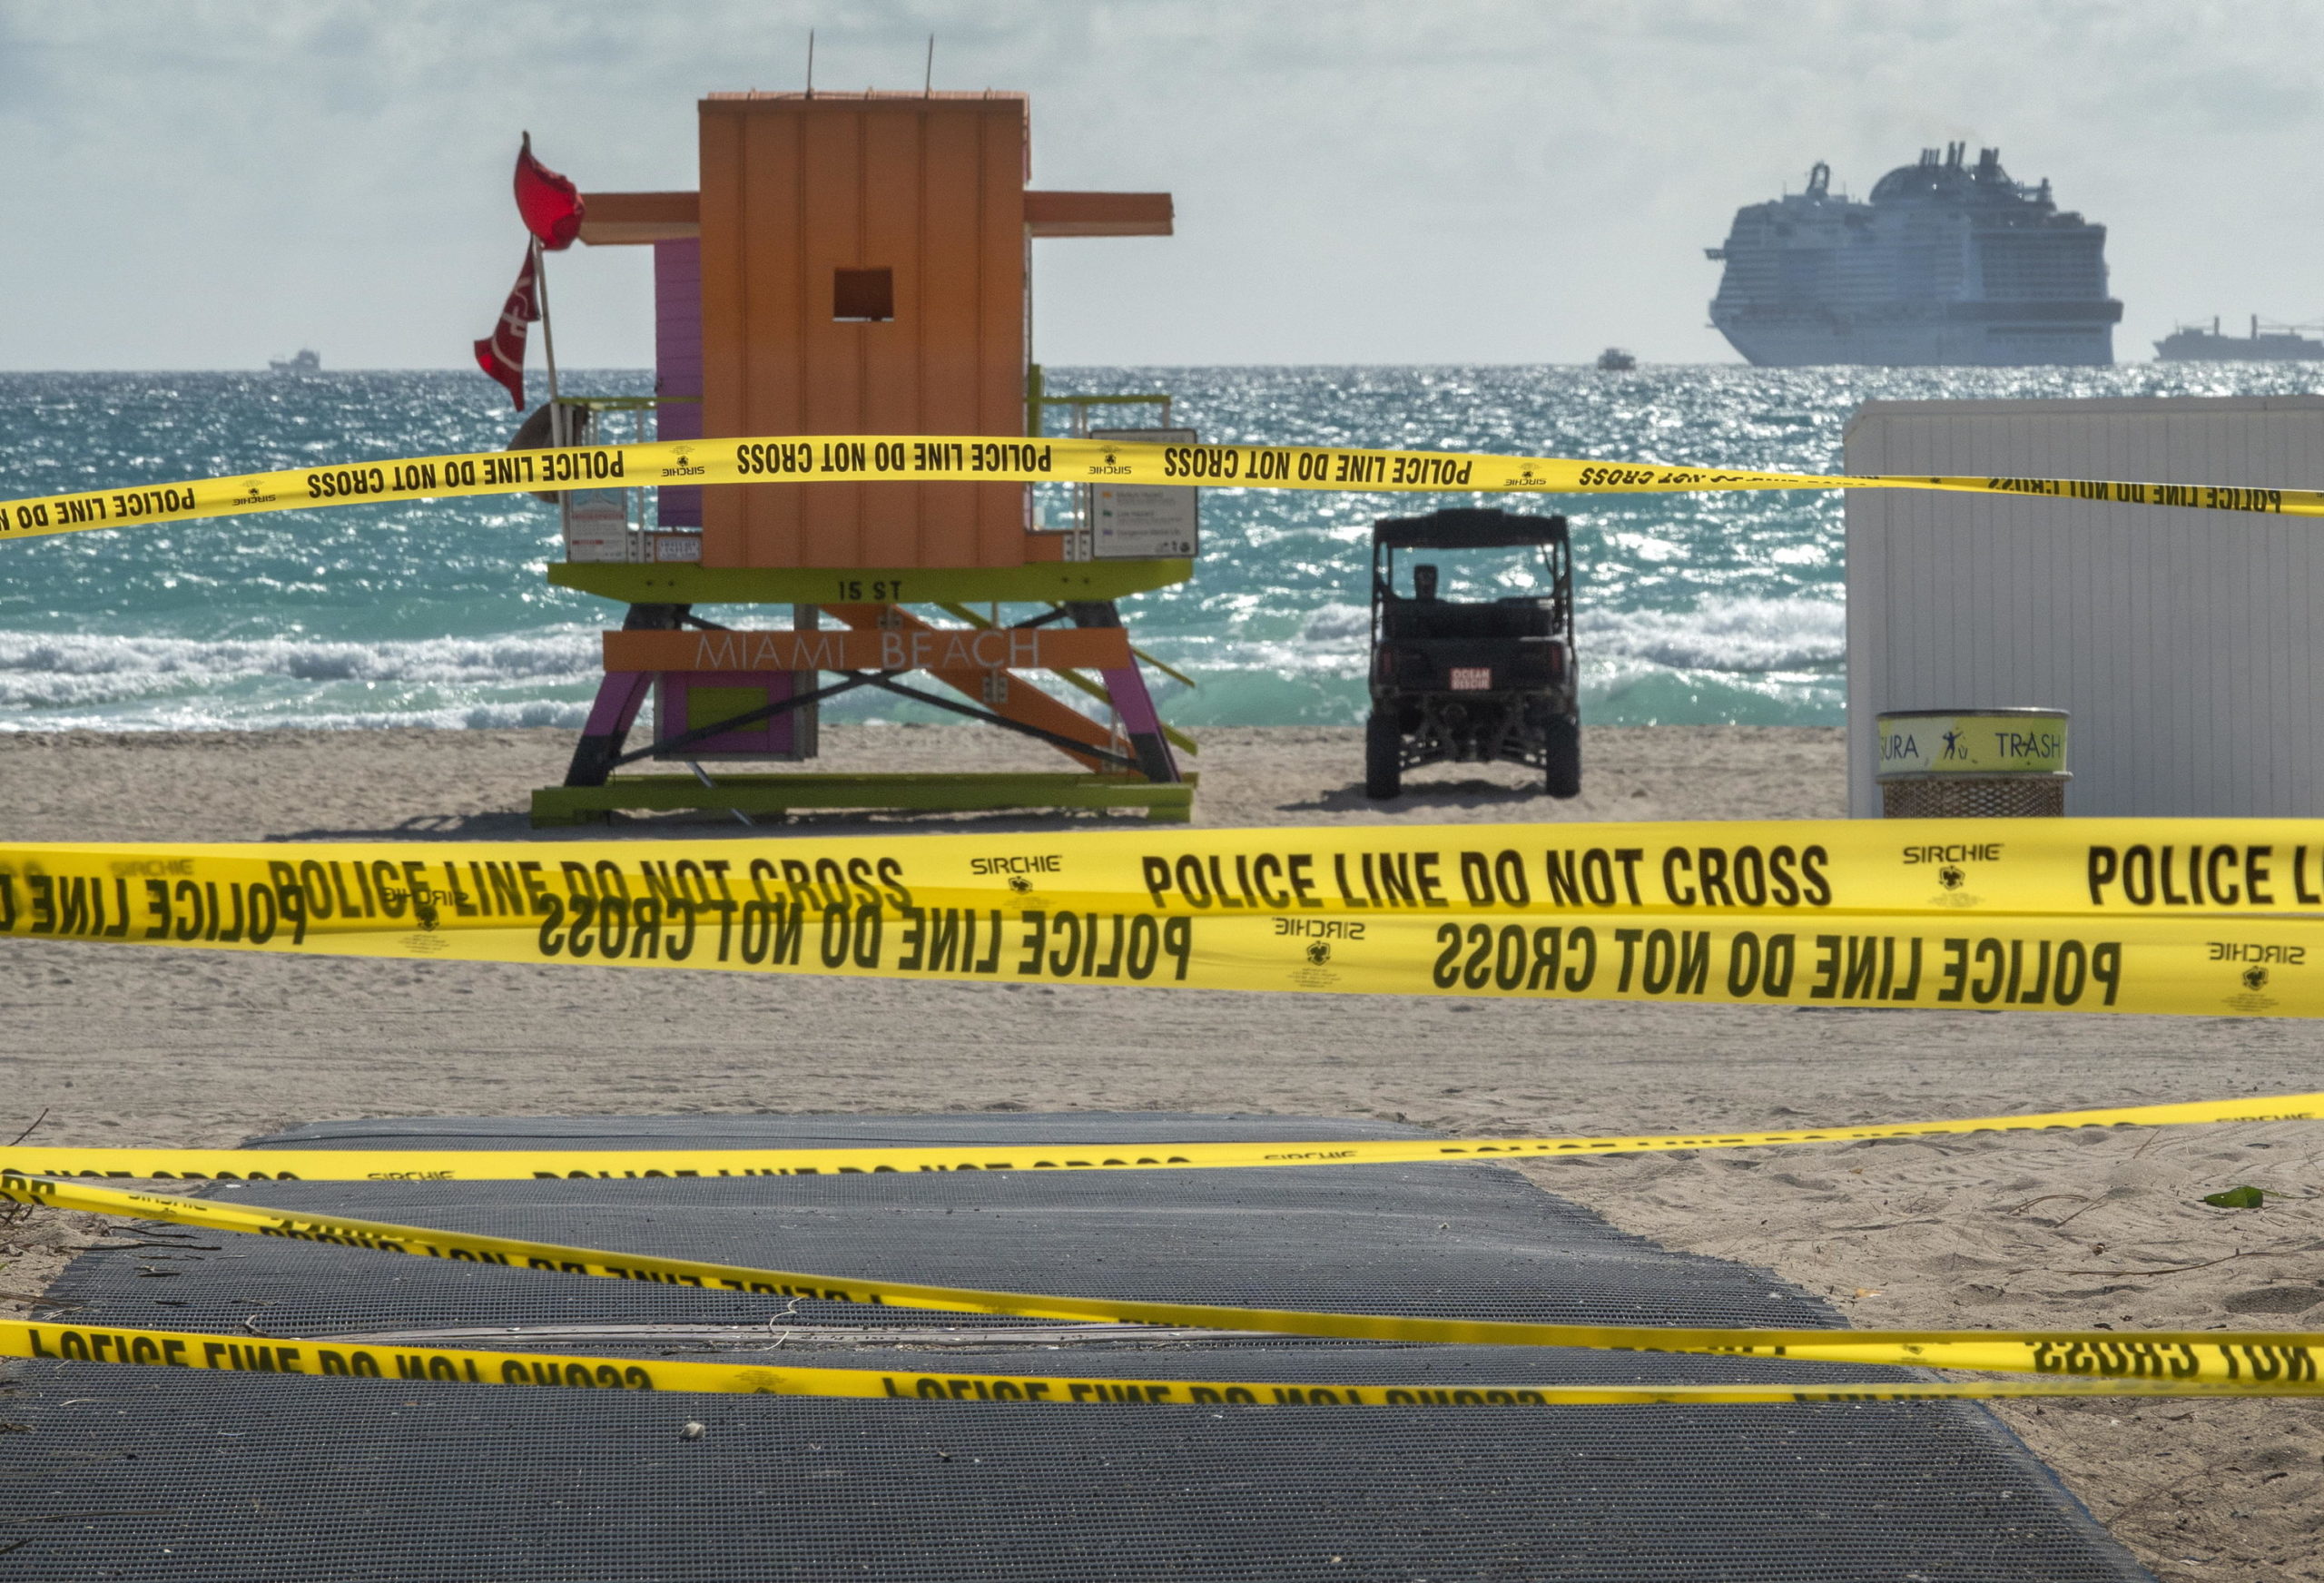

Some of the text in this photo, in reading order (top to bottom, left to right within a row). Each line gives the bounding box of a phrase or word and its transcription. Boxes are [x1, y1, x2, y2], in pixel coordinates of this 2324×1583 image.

[662, 466, 705, 477] SIRCHIE
[736, 442, 1051, 475] POLICE LINE DO NOT CROSS
[1088, 466, 1132, 475] SIRCHIE
[1164, 447, 1472, 485] POLICE LINE DO NOT CROSS
[307, 450, 624, 498] POLICE LINE DO NOT CROSS
[1503, 477, 1547, 487] SIRCHIE
[1579, 467, 1655, 486] CROSS
[57, 497, 107, 525] LINE
[115, 488, 195, 516] POLICE
[232, 494, 276, 506] SIRCHIE
[16, 504, 49, 529] DO
[872, 580, 902, 600] ST
[694, 630, 1039, 671] MIAMI BEACH
[1452, 669, 1491, 679] OCEAN
[1994, 732, 2061, 759] TRASH
[970, 855, 1061, 875] SIRCHIE
[1903, 843, 2002, 864] SIRCHIE
[1142, 845, 1832, 909] POLICE LINE DO NOT CROSS
[2088, 844, 2275, 906] POLICE
[269, 858, 913, 920] POLICE LINE DO NOT CROSS
